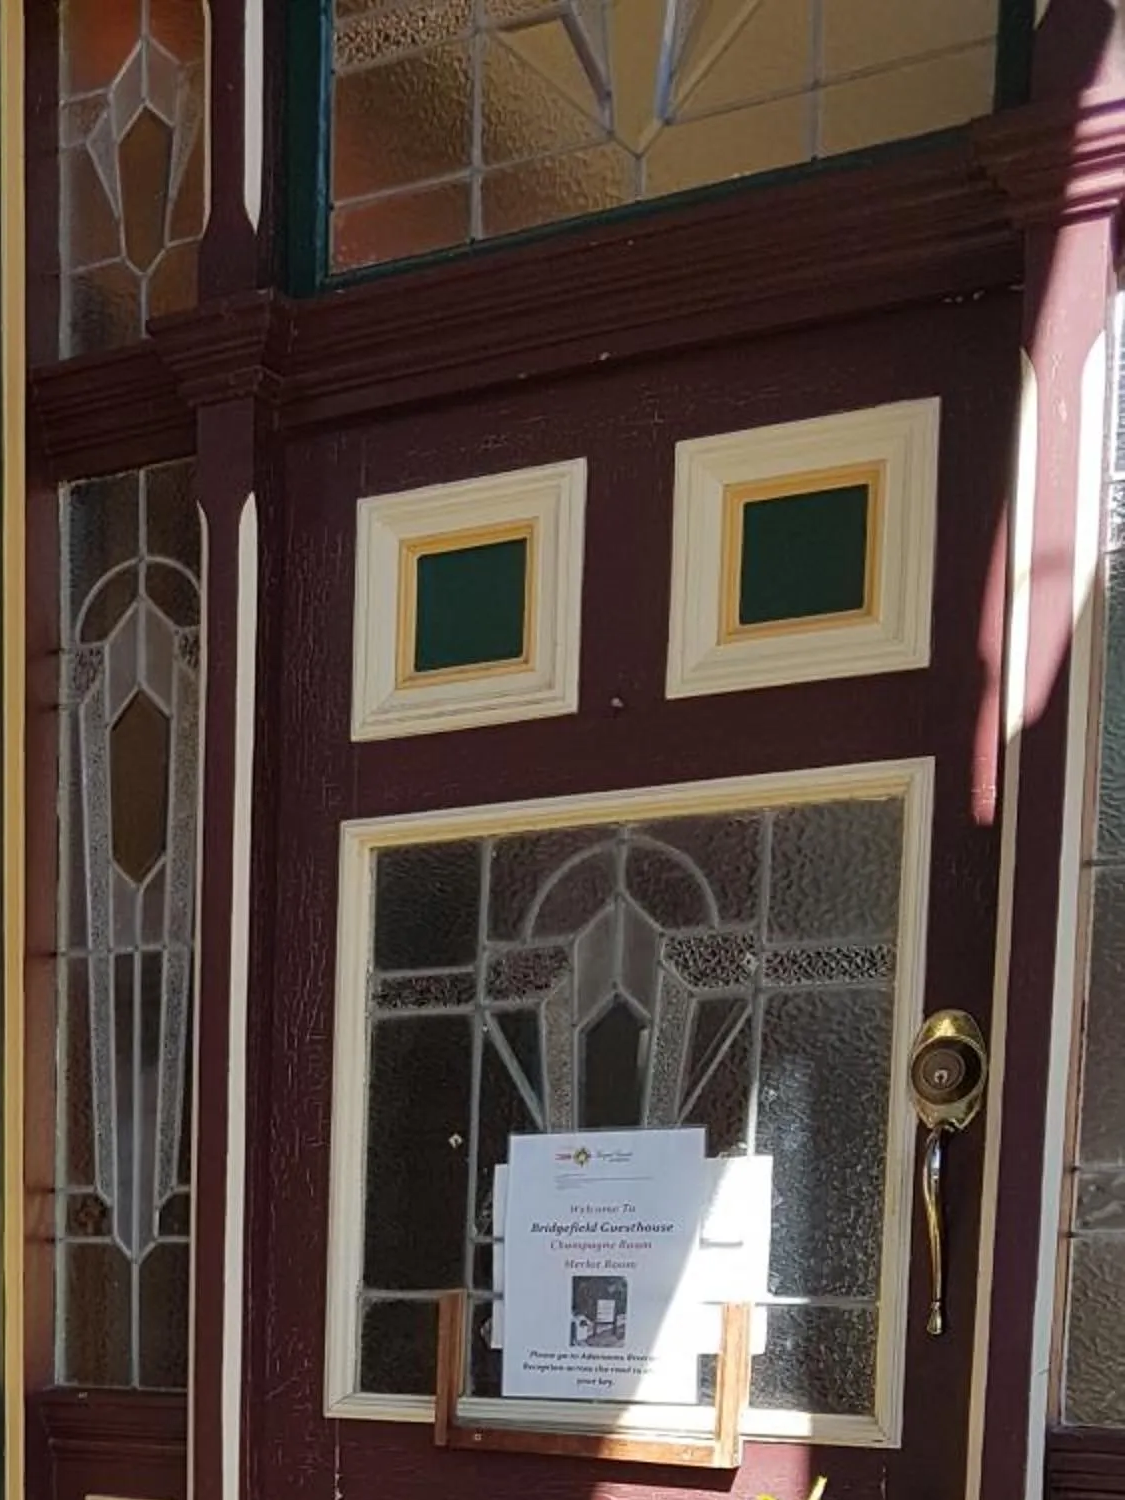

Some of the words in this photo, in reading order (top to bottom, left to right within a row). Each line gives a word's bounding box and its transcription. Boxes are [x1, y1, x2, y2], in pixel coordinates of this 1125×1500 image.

[570, 1204, 618, 1214] Welcome
[622, 1203, 636, 1213] To
[530, 1222, 597, 1235] Bridgefield
[600, 1221, 674, 1233] Guesthouse
[550, 1239, 616, 1250] Champagne
[618, 1239, 652, 1249] Room
[564, 1259, 600, 1269] Merlot
[604, 1259, 638, 1269] Room
